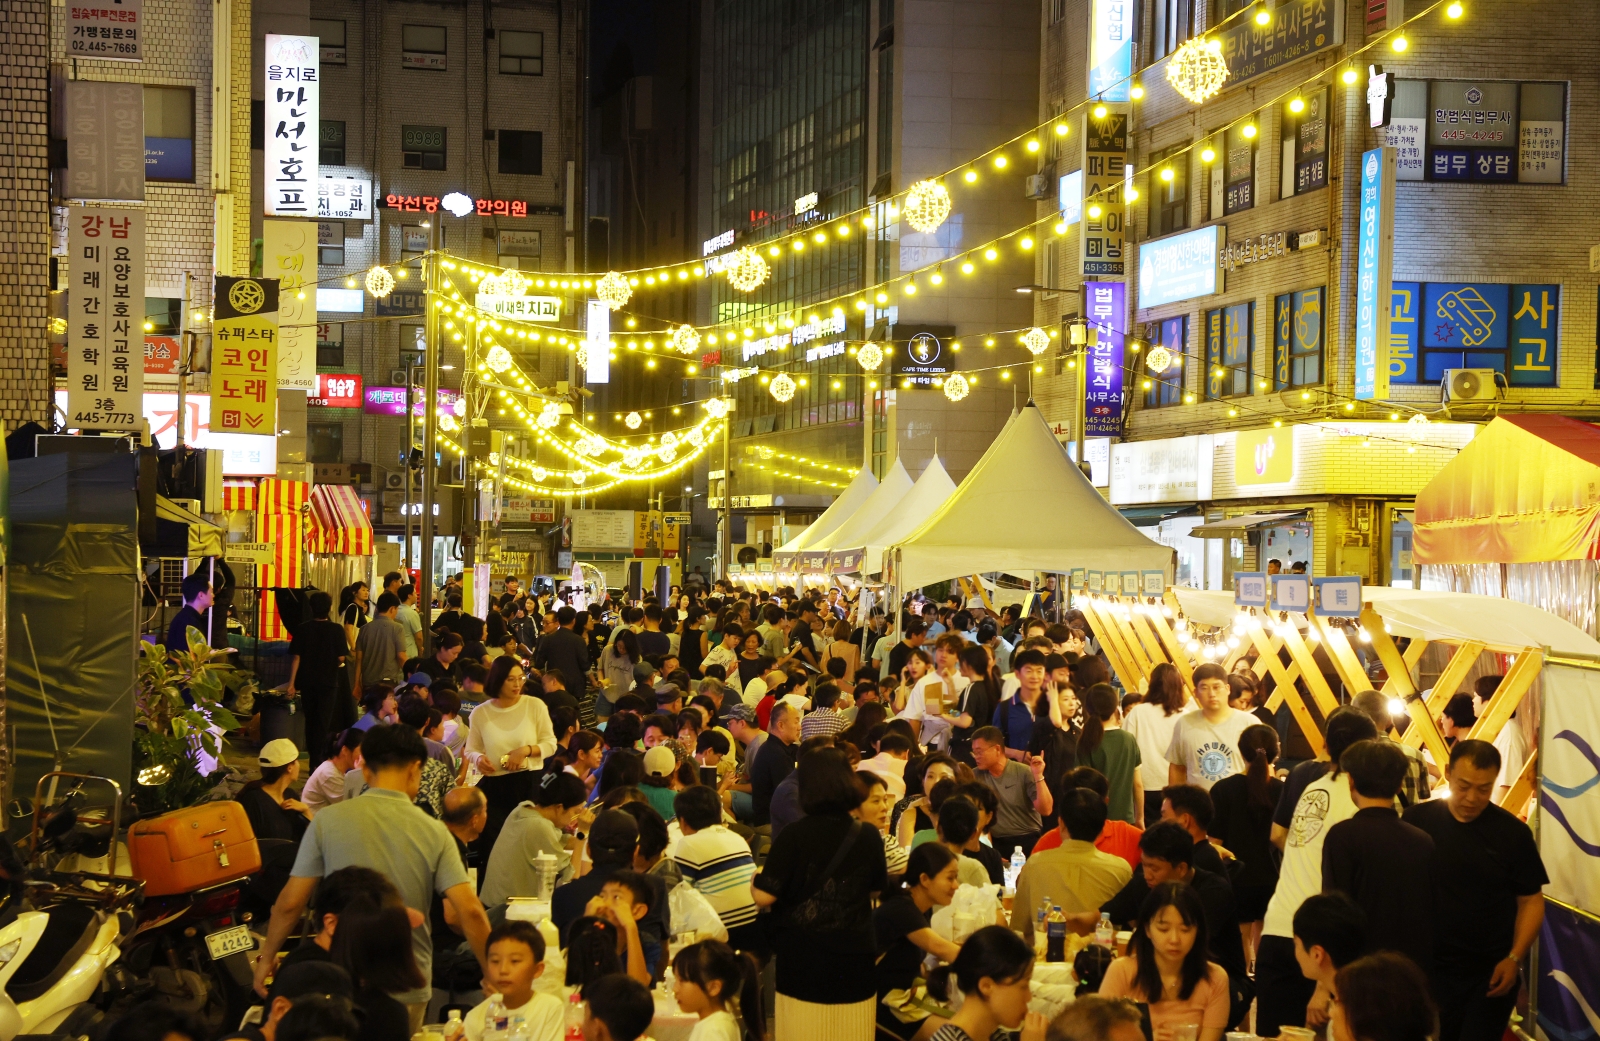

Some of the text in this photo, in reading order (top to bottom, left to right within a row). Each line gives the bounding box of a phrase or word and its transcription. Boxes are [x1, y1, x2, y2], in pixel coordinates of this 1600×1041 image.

[71, 7, 136, 23] 참숯화로전문점
[1107, 0, 1124, 41] 신협
[73, 26, 137, 40] 가맹점문의
[72, 41, 137, 53] 02.445-7669
[267, 64, 318, 82] 을지로
[1435, 108, 1512, 126] 한범식 법무사
[405, 131, 442, 146] 9988
[1440, 129, 1504, 142] 445-4245
[275, 86, 308, 212] 만선호프
[1434, 154, 1511, 175] 법무 상담
[385, 194, 440, 213] 약선당
[474, 199, 528, 218] 한의원
[81, 214, 132, 239] 강남
[1084, 263, 1124, 272] 451-3355
[495, 300, 558, 317] 이재학 치과
[81, 245, 101, 392] 미래간호학원
[111, 246, 132, 393] 요양보호사교육원
[217, 326, 275, 343] 슈퍼스타
[1513, 290, 1555, 372] 사고
[220, 348, 269, 373] 코인
[219, 379, 267, 404] 노래
[327, 378, 356, 398] 연습장
[94, 398, 116, 410] 3층
[1085, 391, 1120, 403] 사무소
[74, 411, 135, 424] 445-7773
[223, 412, 240, 426] B1
[222, 935, 251, 952] 4242
